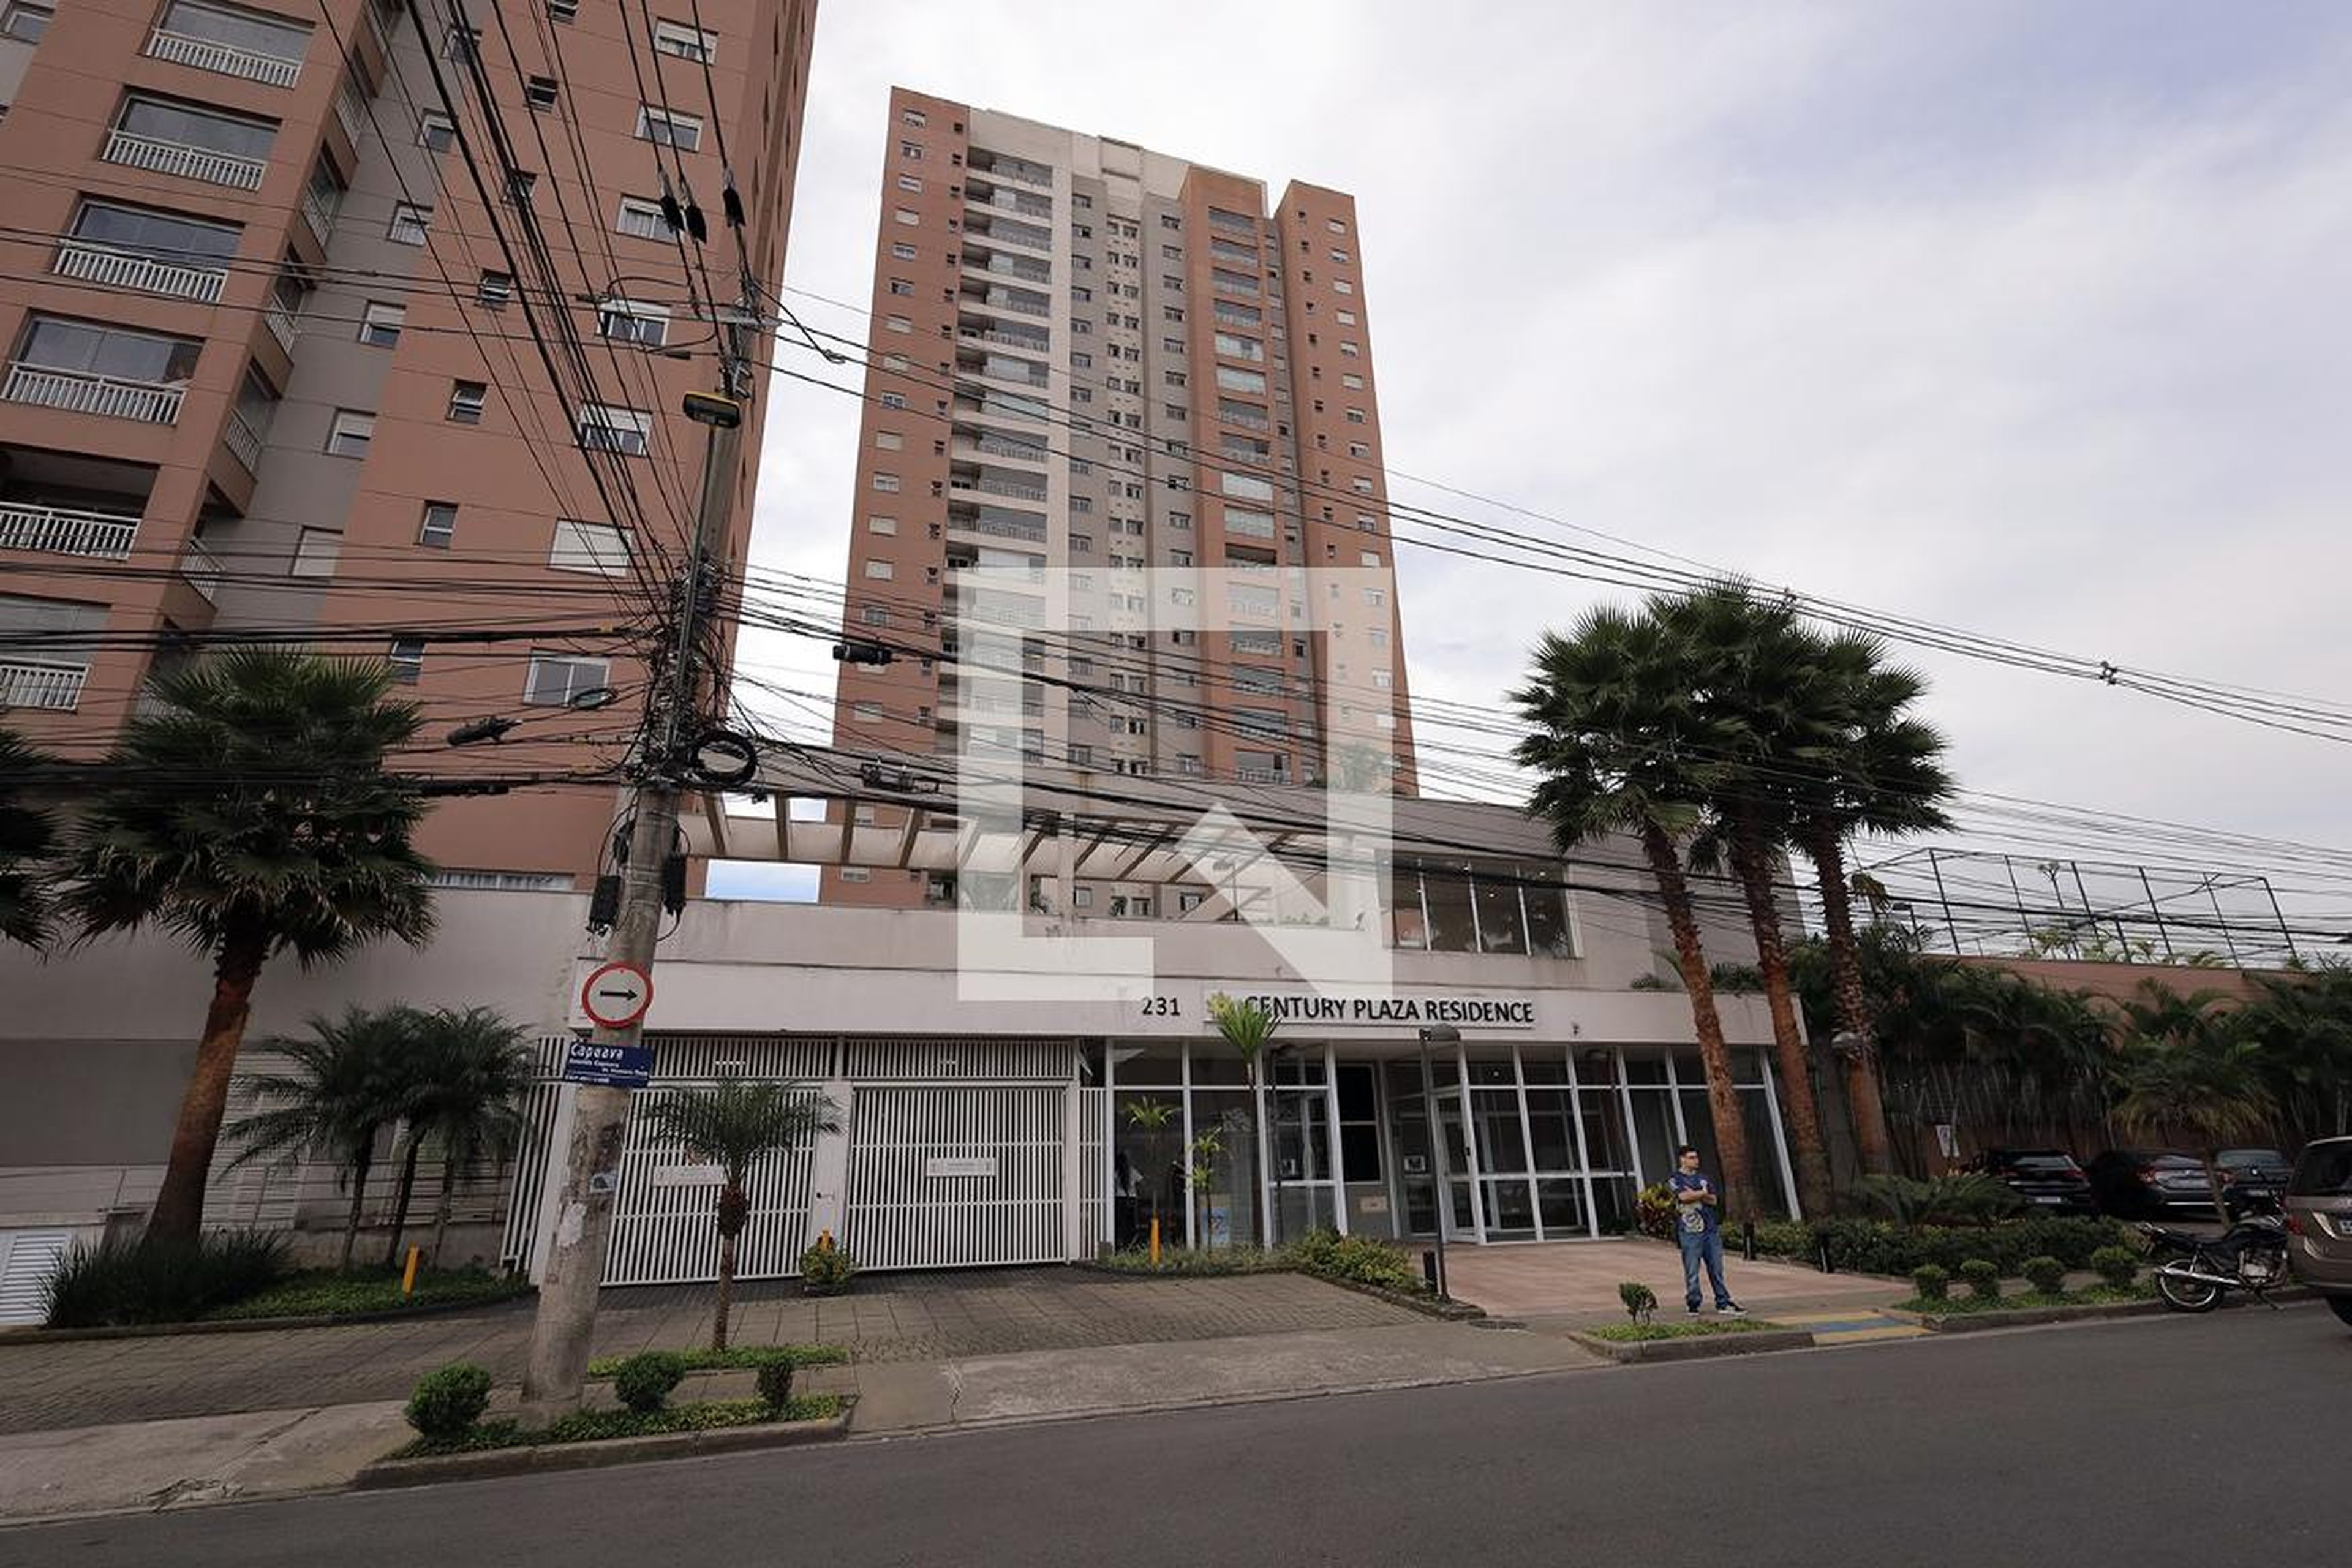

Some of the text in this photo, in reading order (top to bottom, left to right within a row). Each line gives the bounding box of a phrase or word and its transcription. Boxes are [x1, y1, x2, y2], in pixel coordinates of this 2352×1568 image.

[1142, 997, 1181, 1016] 231
[1354, 999, 1419, 1020] PLAZA
[1426, 1000, 1534, 1022] RESIDENCE
